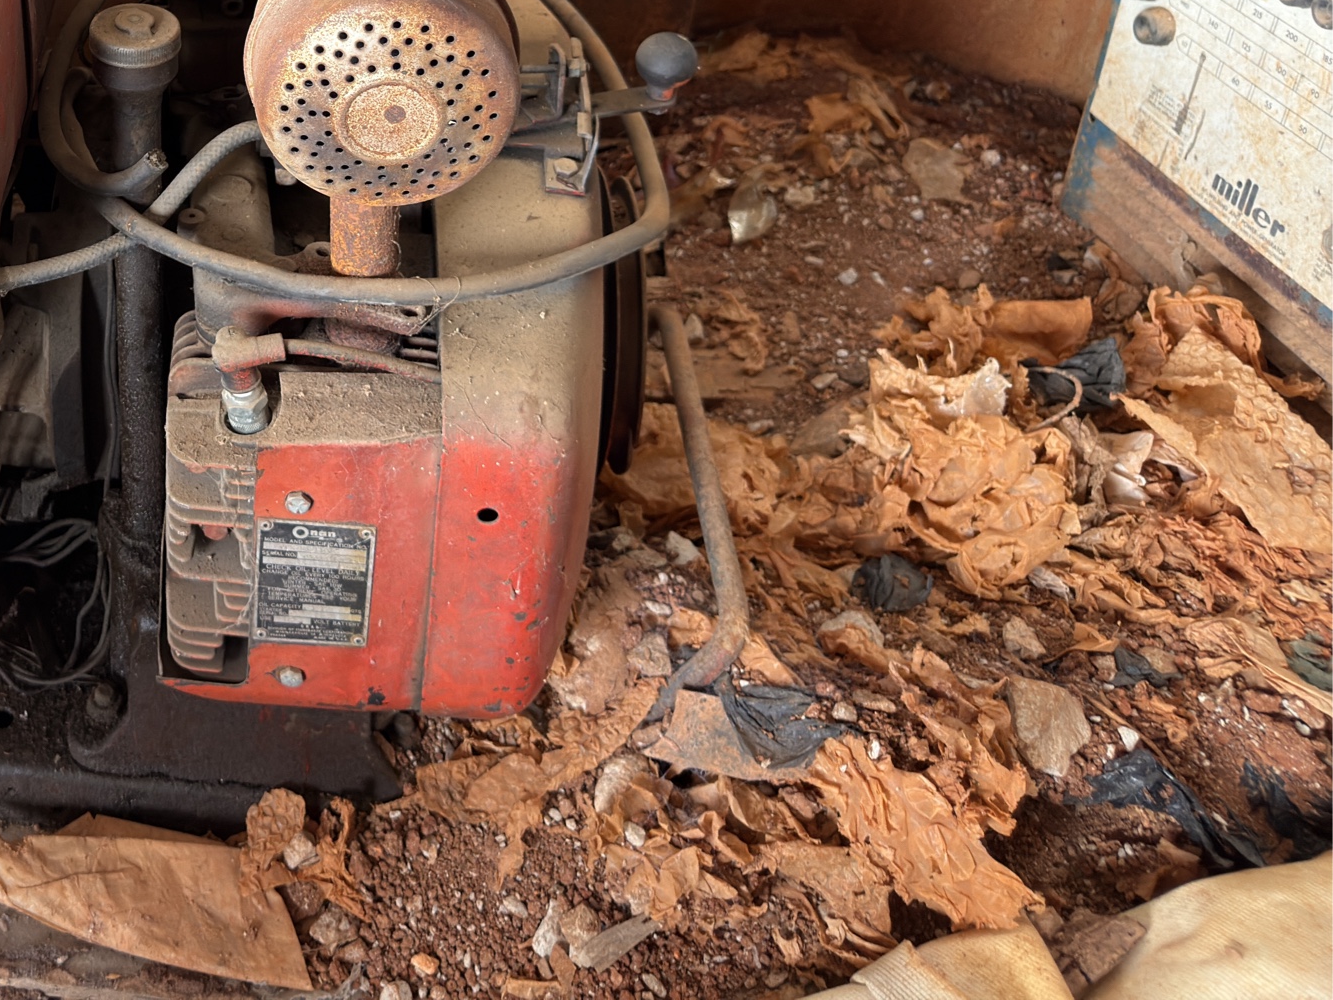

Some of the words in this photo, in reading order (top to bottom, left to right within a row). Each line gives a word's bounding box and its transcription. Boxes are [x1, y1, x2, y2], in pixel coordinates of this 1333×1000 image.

[1208, 18, 1219, 30] 140
[1241, 41, 1251, 53] 125
[1276, 66, 1287, 77] 100
[1310, 88, 1320, 99] 90
[1253, 8, 1263, 20] 215
[1285, 30, 1298, 42] 200
[1322, 53, 1333, 65] 185
[1231, 77, 1240, 87] 60
[1264, 100, 1272, 110] 55
[1298, 124, 1307, 134] 50
[1211, 173, 1285, 237] miller
[292, 526, 336, 539] Onan
[305, 540, 354, 549] SPECIFICATION
[266, 563, 292, 571] CHECK
